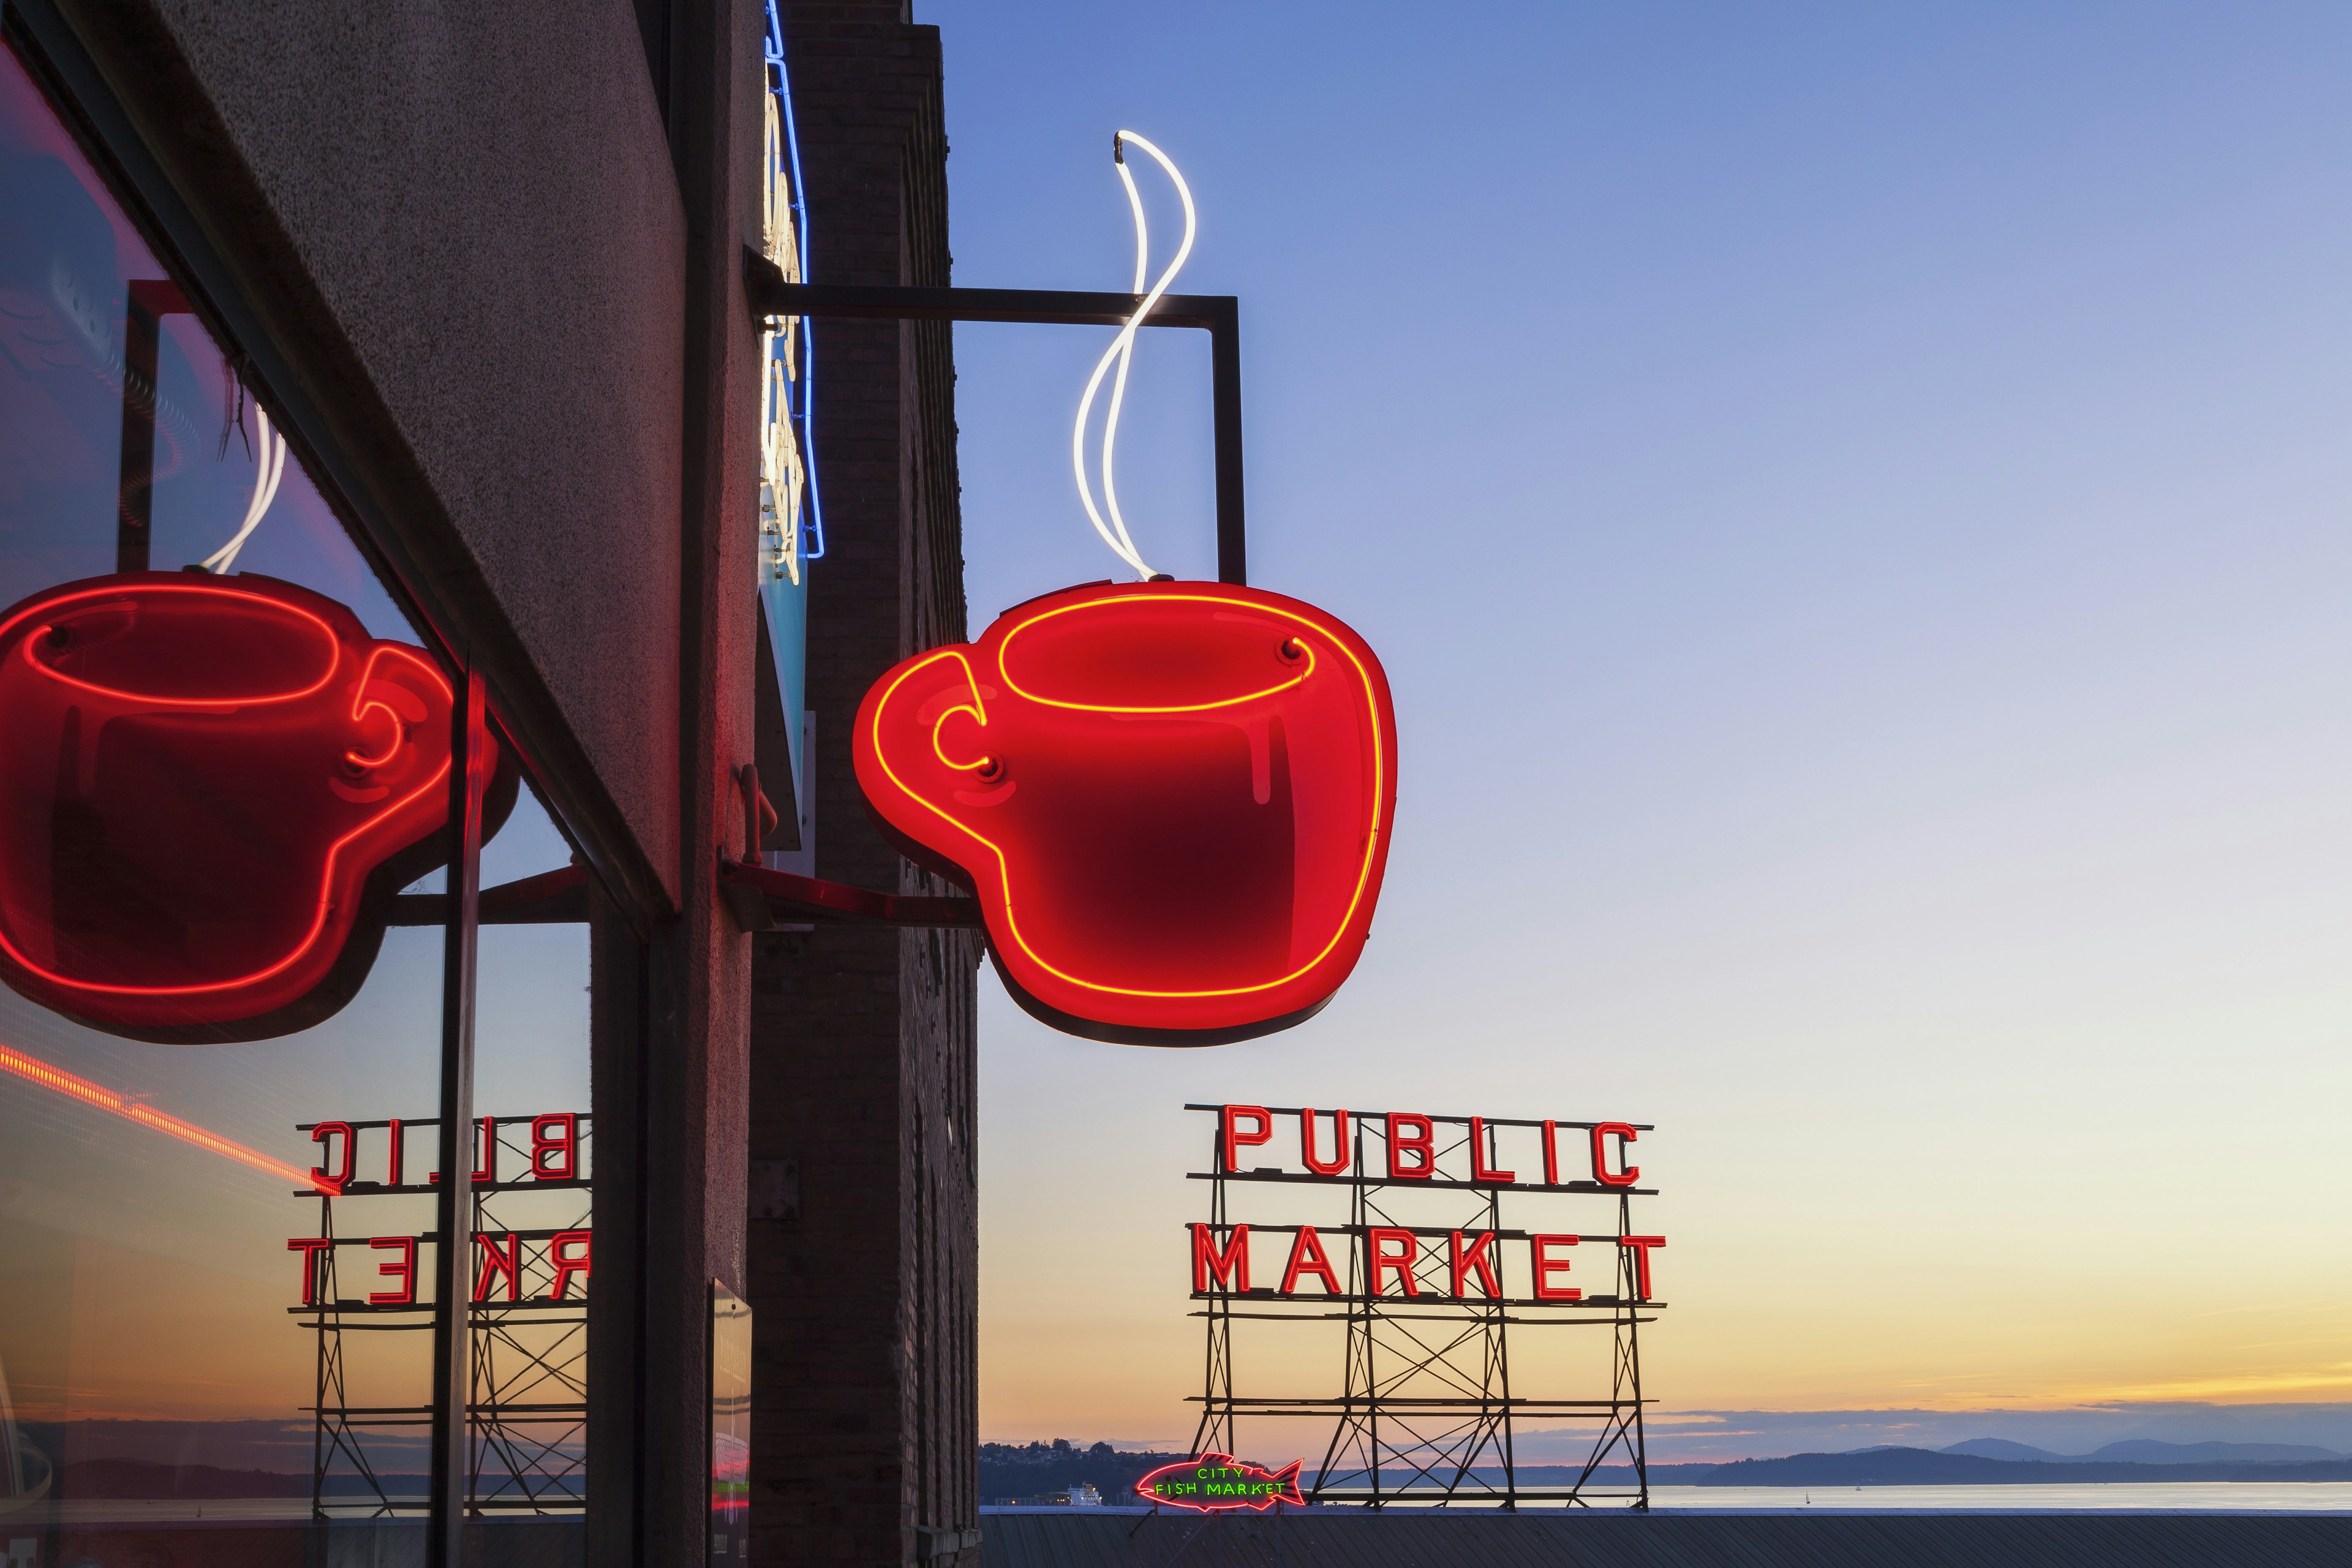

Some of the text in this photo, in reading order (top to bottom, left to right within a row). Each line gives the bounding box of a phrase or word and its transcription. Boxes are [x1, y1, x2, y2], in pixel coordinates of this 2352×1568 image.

[1224, 1104, 1640, 1186] PUBLIC
[1192, 1223, 1666, 1300] MARKET
[1155, 1482, 1285, 1495] FISH MARKET
[1197, 1467, 1244, 1479] CITY
